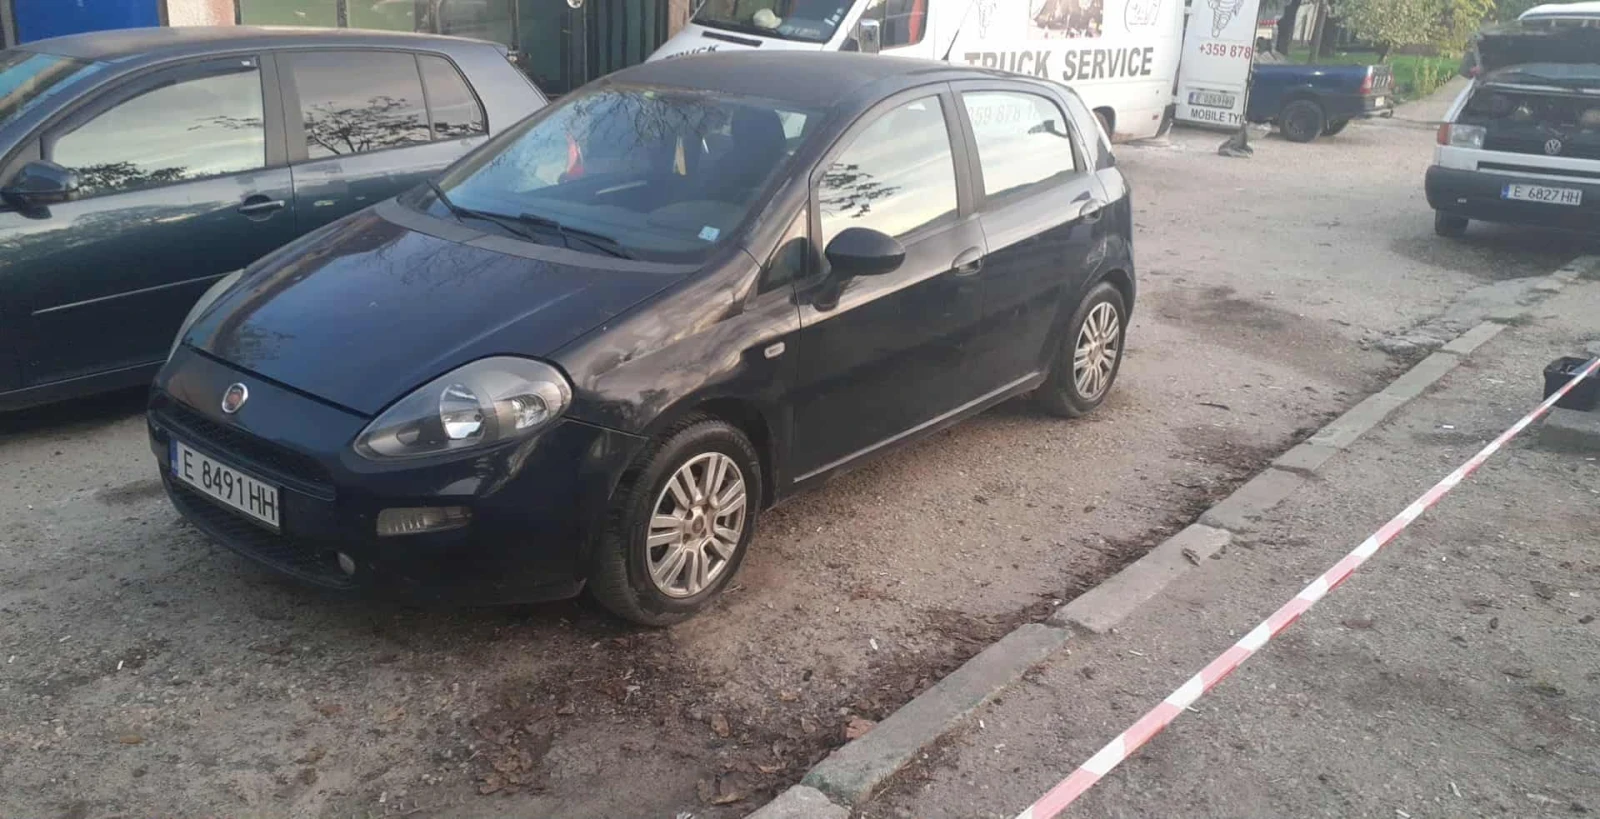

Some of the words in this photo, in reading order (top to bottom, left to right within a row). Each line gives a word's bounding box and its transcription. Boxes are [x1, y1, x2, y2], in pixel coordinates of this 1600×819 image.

[1200, 43, 1226, 56] +359
[1230, 45, 1251, 59] 878
[1063, 46, 1154, 81] SERVICE
[1190, 108, 1226, 122] MOBILE
[1514, 185, 1521, 198] E
[183, 449, 194, 481] E
